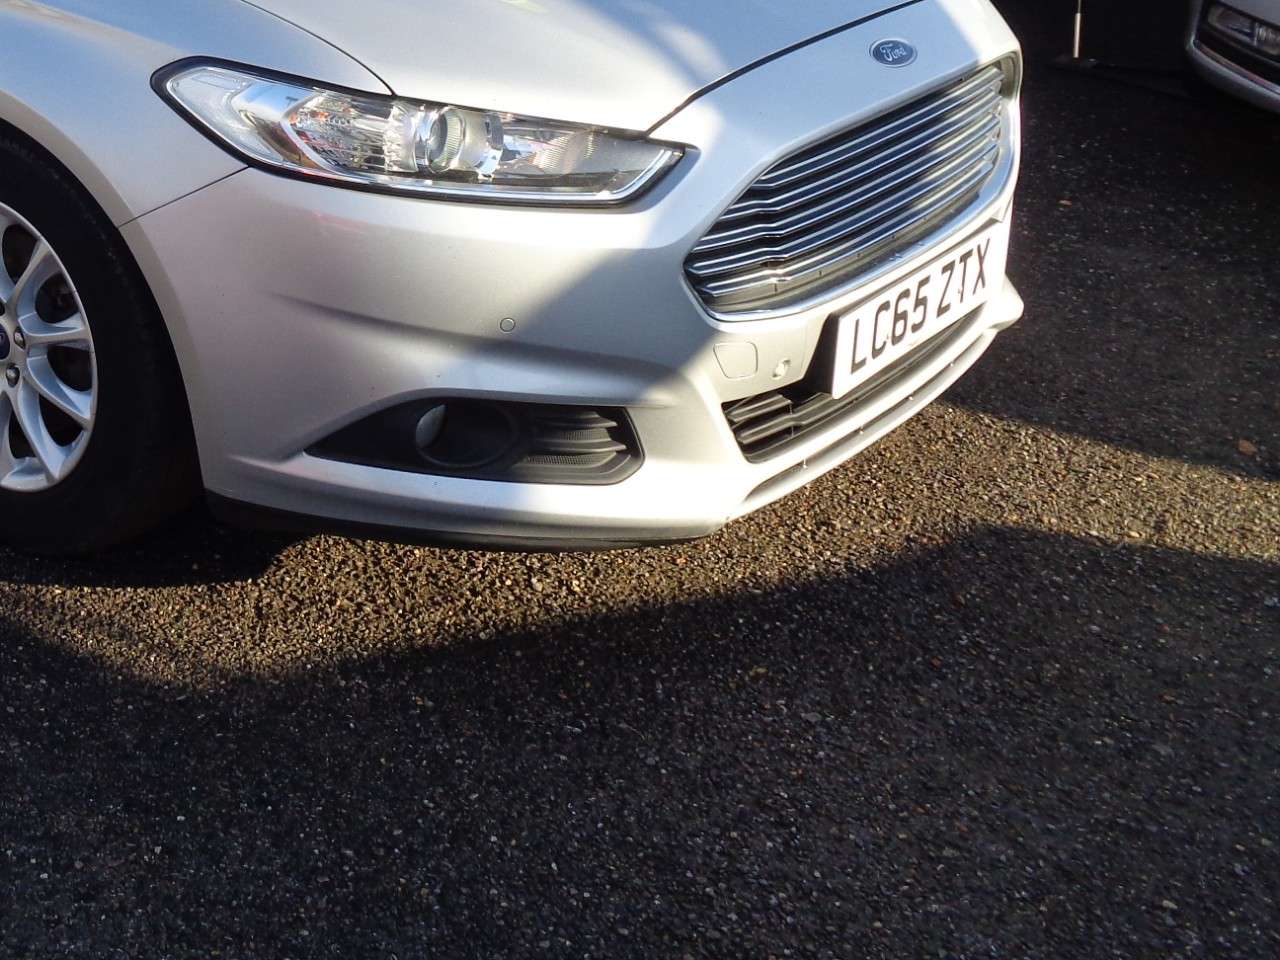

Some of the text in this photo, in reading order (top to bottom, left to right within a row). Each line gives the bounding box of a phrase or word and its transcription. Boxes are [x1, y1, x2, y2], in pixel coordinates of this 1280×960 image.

[880, 43, 907, 61] Ford
[850, 238, 991, 375] LC65 ZTX
